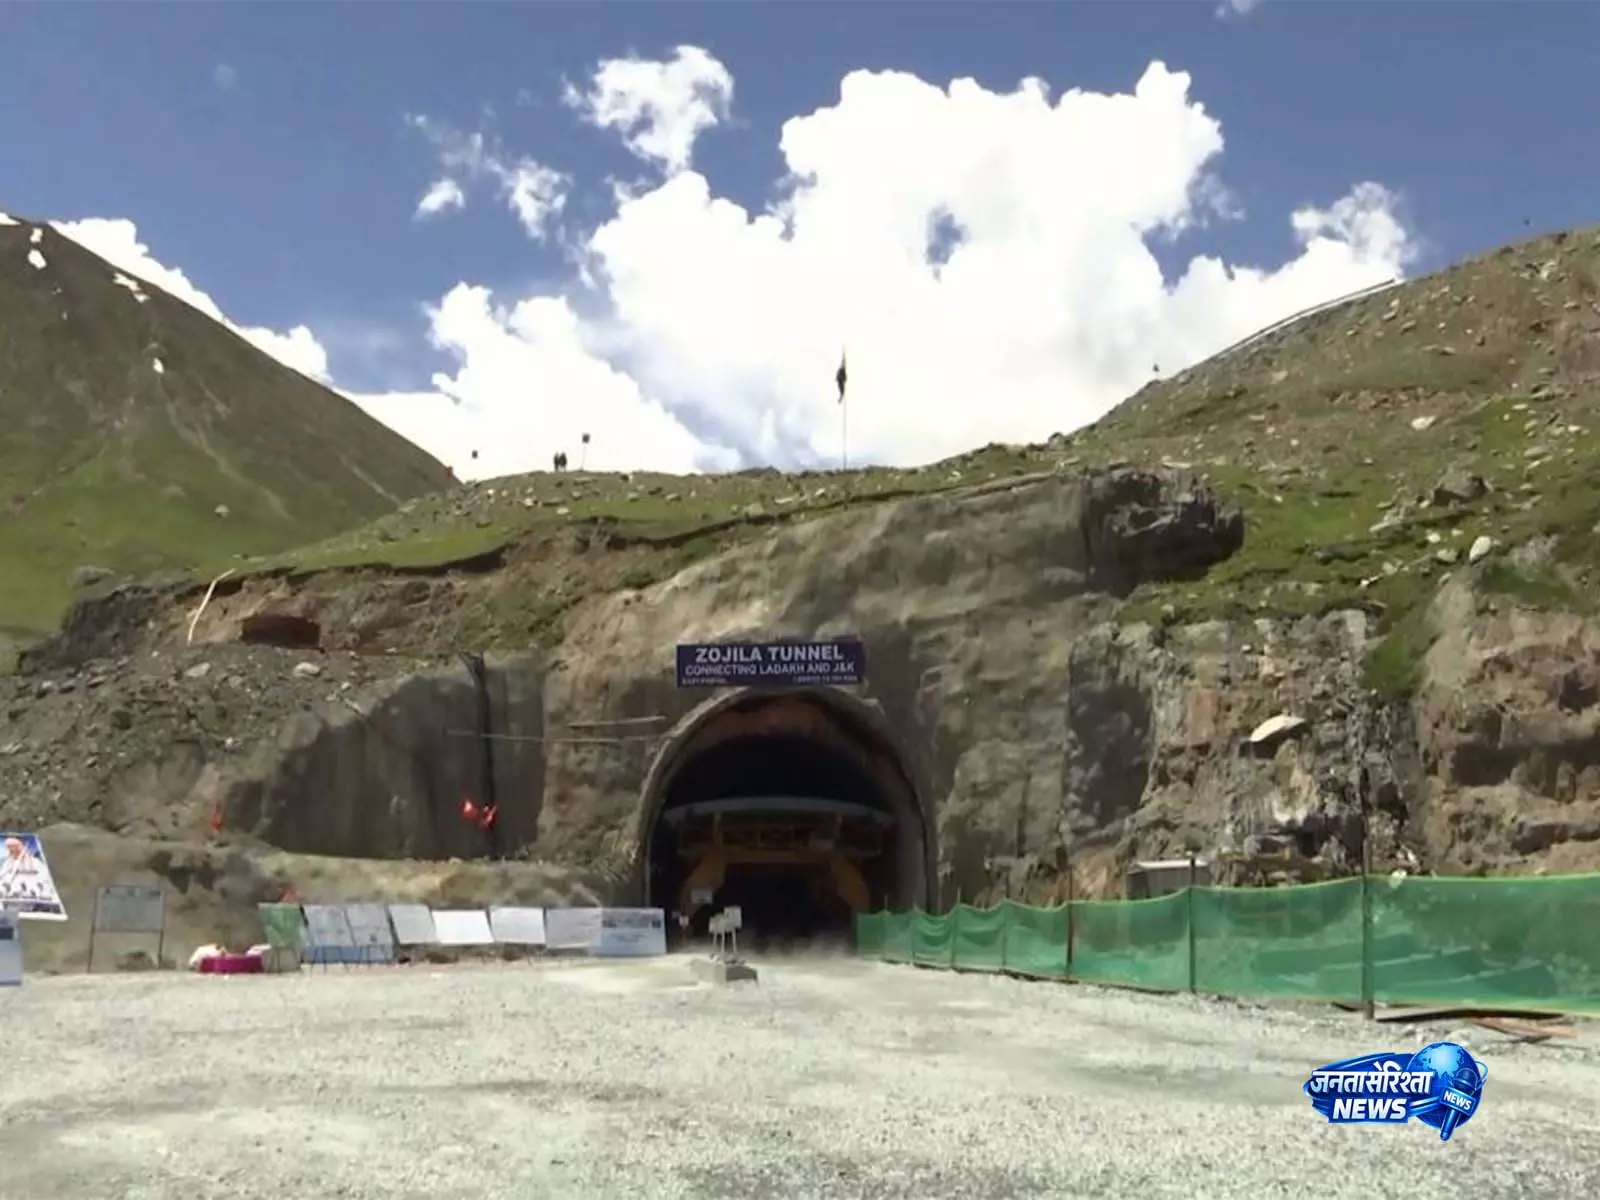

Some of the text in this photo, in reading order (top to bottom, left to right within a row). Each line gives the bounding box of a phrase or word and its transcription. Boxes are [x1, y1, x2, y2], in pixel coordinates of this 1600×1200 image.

[696, 645, 844, 662] ZOJILA TUNNEL
[685, 662, 855, 676] CONNECTING LADAKH AND J&K
